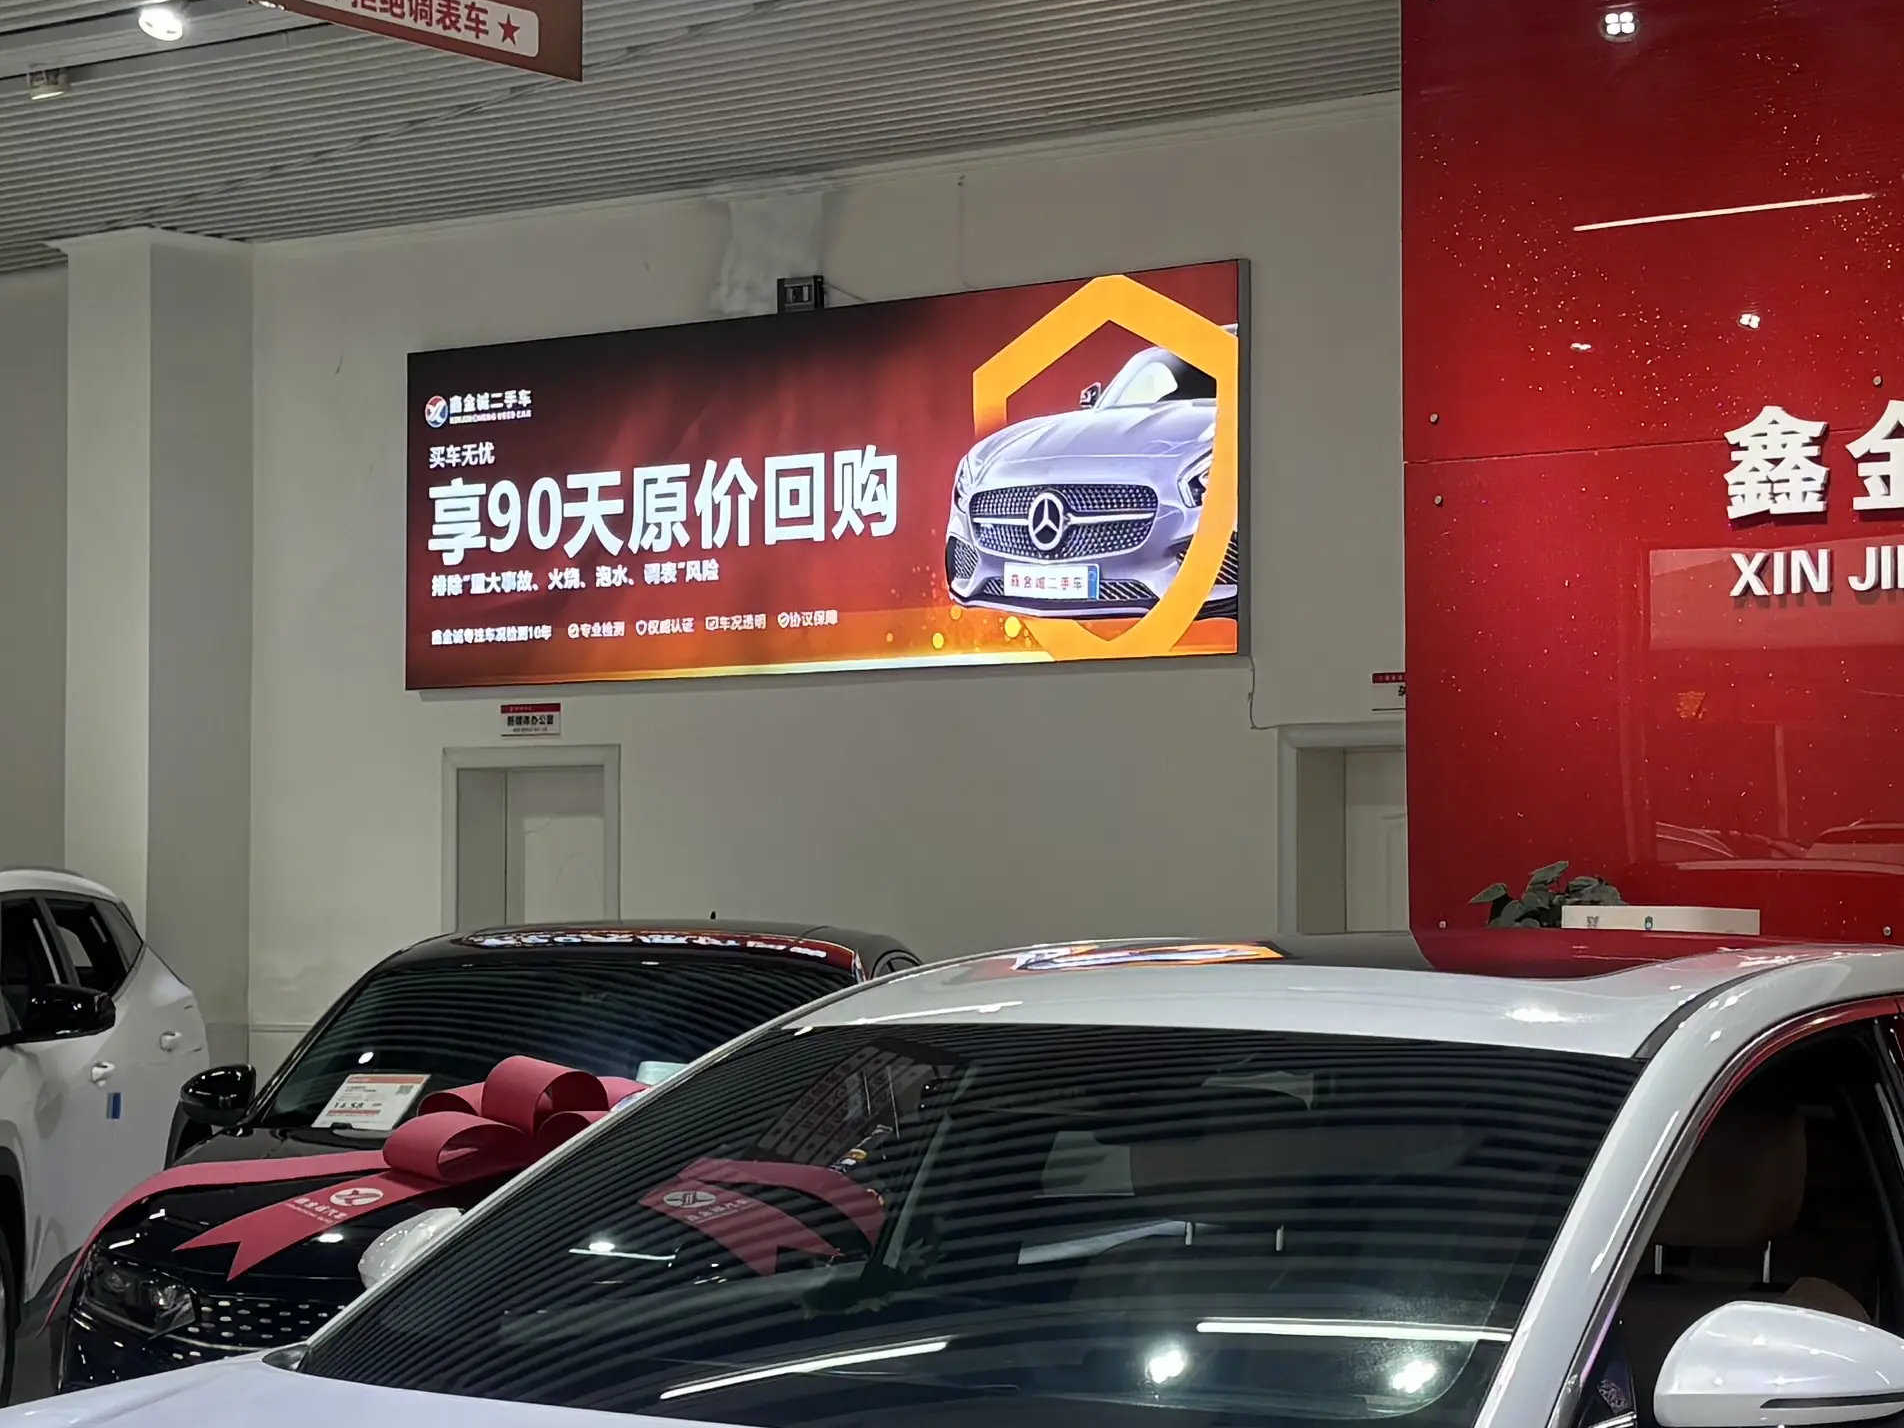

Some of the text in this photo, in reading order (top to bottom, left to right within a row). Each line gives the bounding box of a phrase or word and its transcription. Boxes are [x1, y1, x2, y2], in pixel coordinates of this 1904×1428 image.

[449, 389, 532, 414] 鑫金诚二手车
[428, 441, 496, 469] 买车无忧
[427, 444, 899, 566] 享90天原价回购
[1011, 574, 1083, 590] 鑫金诚二手车
[1729, 549, 1832, 598] XIN
[580, 620, 625, 638] 专业检测
[648, 617, 695, 635] 权威认证
[718, 613, 767, 631] 车况透明
[789, 609, 838, 628] 协议保障
